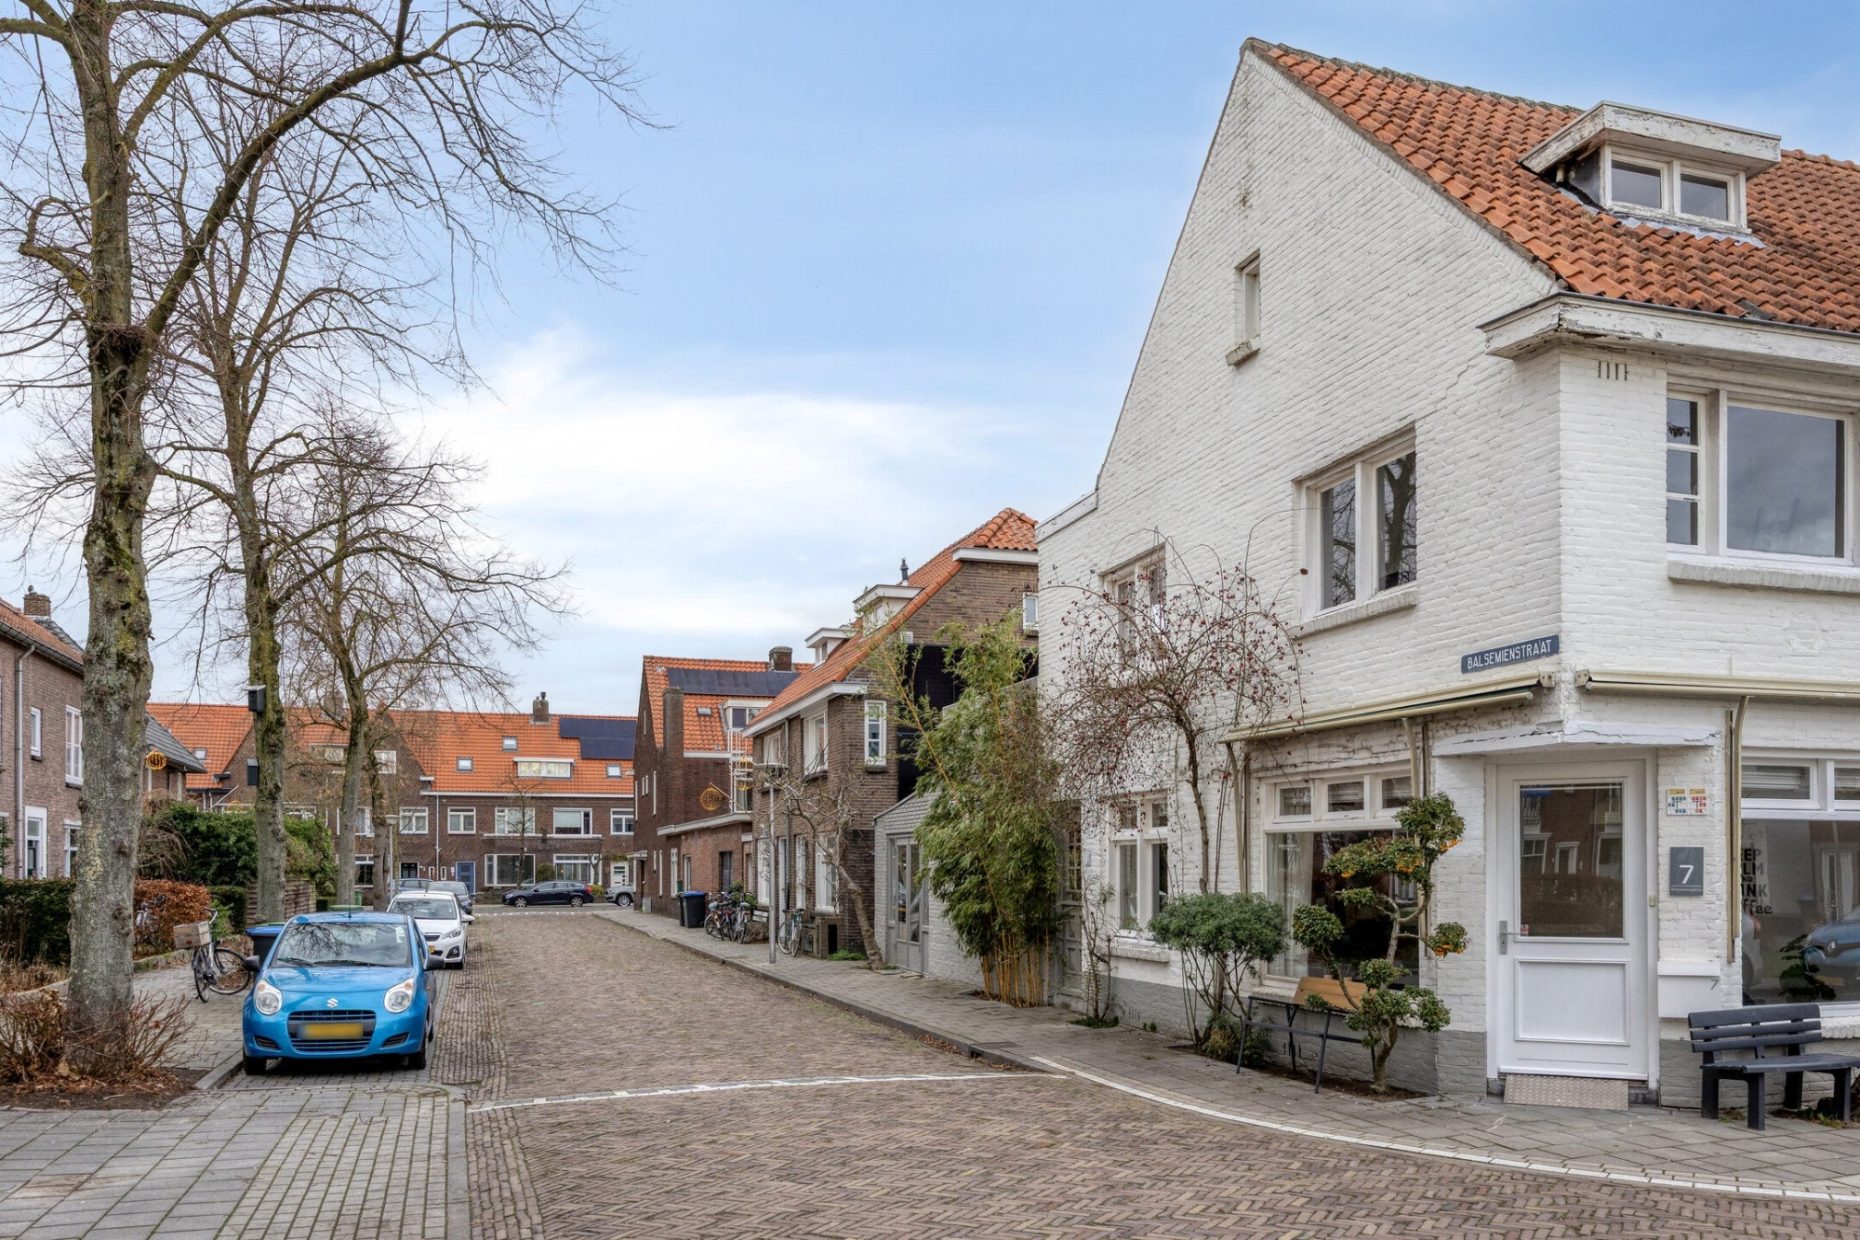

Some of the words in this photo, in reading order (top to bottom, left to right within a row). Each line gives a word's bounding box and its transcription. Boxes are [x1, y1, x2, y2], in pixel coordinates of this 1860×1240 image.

[1467, 640, 1551, 669] BALSEMIENSTRAAT
[1741, 848, 1761, 862] EP
[1679, 865, 1694, 884] 7
[1743, 863, 1764, 875] LM
[1741, 884, 1768, 897] INK
[1743, 899, 1773, 916] ffee
[1710, 979, 1719, 990] 7
